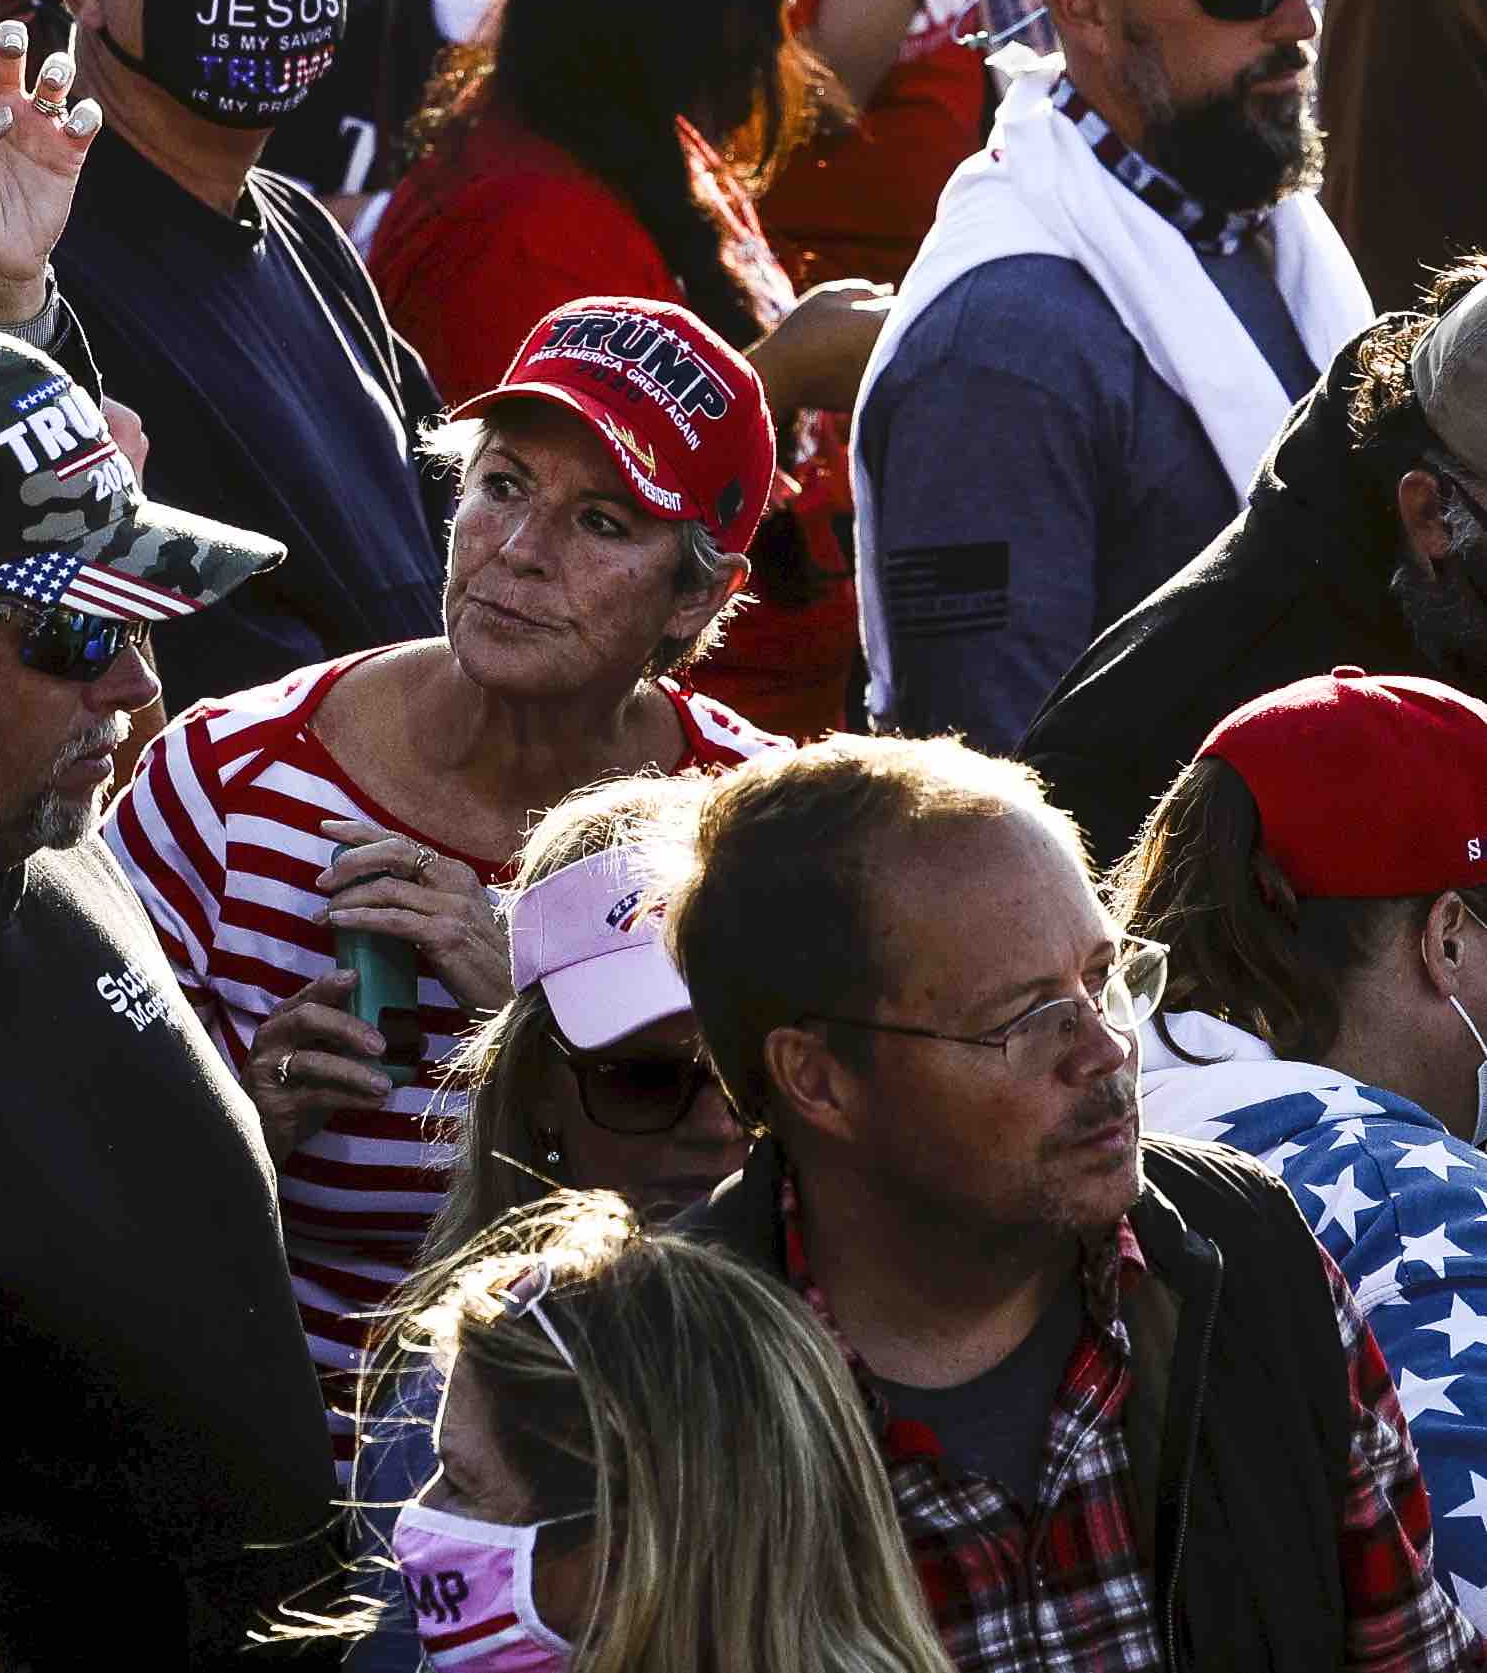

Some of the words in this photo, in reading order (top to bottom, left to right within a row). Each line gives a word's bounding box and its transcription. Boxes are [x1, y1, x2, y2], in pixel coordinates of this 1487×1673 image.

[211, 32, 230, 49] IS
[239, 35, 270, 52] MY
[195, 42, 335, 96] TRUMP
[218, 95, 249, 113] MY
[539, 315, 729, 421] TRUMP
[560, 347, 624, 374] AMERICA
[625, 365, 671, 407] GREAT
[663, 403, 703, 452] AGAIN
[629, 461, 683, 512] PRESIDENT
